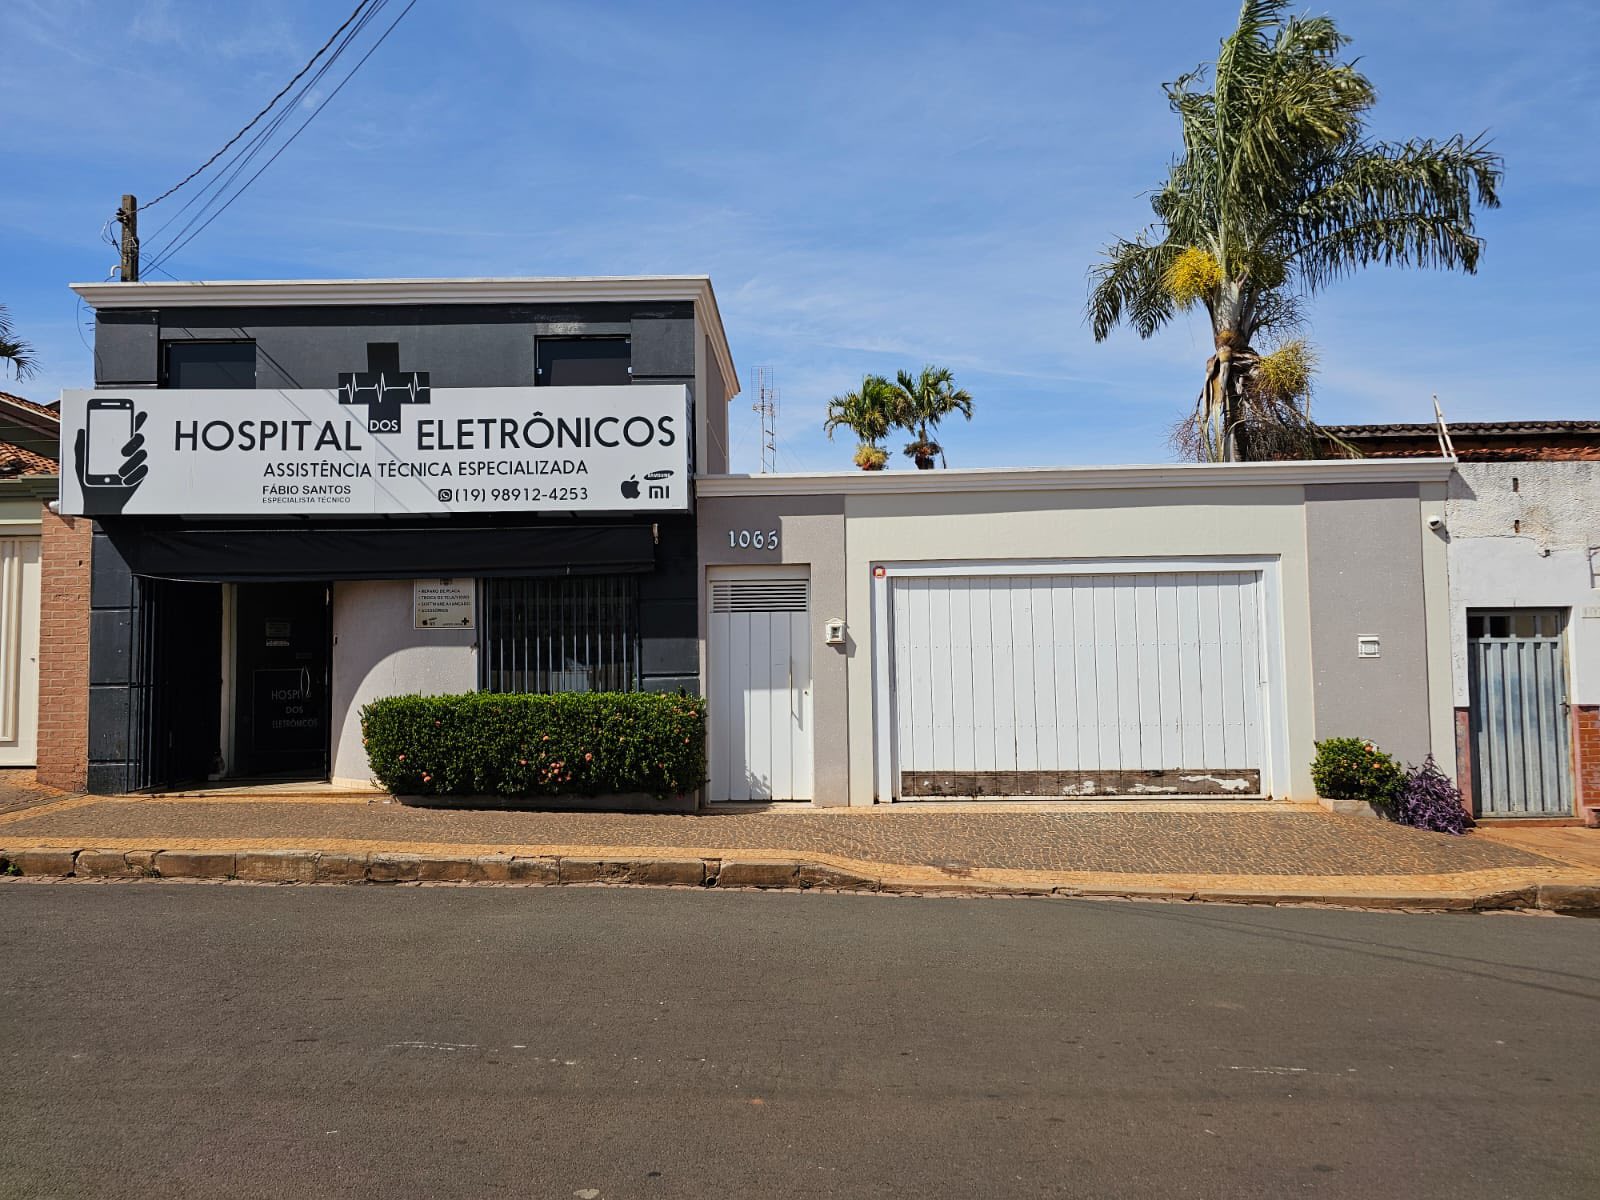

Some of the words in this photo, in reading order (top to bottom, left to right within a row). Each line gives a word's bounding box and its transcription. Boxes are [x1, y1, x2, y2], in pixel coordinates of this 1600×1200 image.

[175, 420, 362, 451] HOSPITAL
[369, 419, 399, 431] DOS
[417, 411, 675, 450] ELETRÔNICOS
[263, 460, 372, 478] ASSISTÊNCIA
[378, 460, 452, 478] TÉCNICA
[458, 459, 588, 476] ESPECIALIZADA
[262, 484, 299, 495] FÁBIO
[302, 485, 351, 495] SANTOS
[455, 488, 486, 502] (19)
[491, 487, 588, 502] 98912-4253
[318, 496, 351, 504] TÉCNICO
[729, 530, 779, 550] 1065
